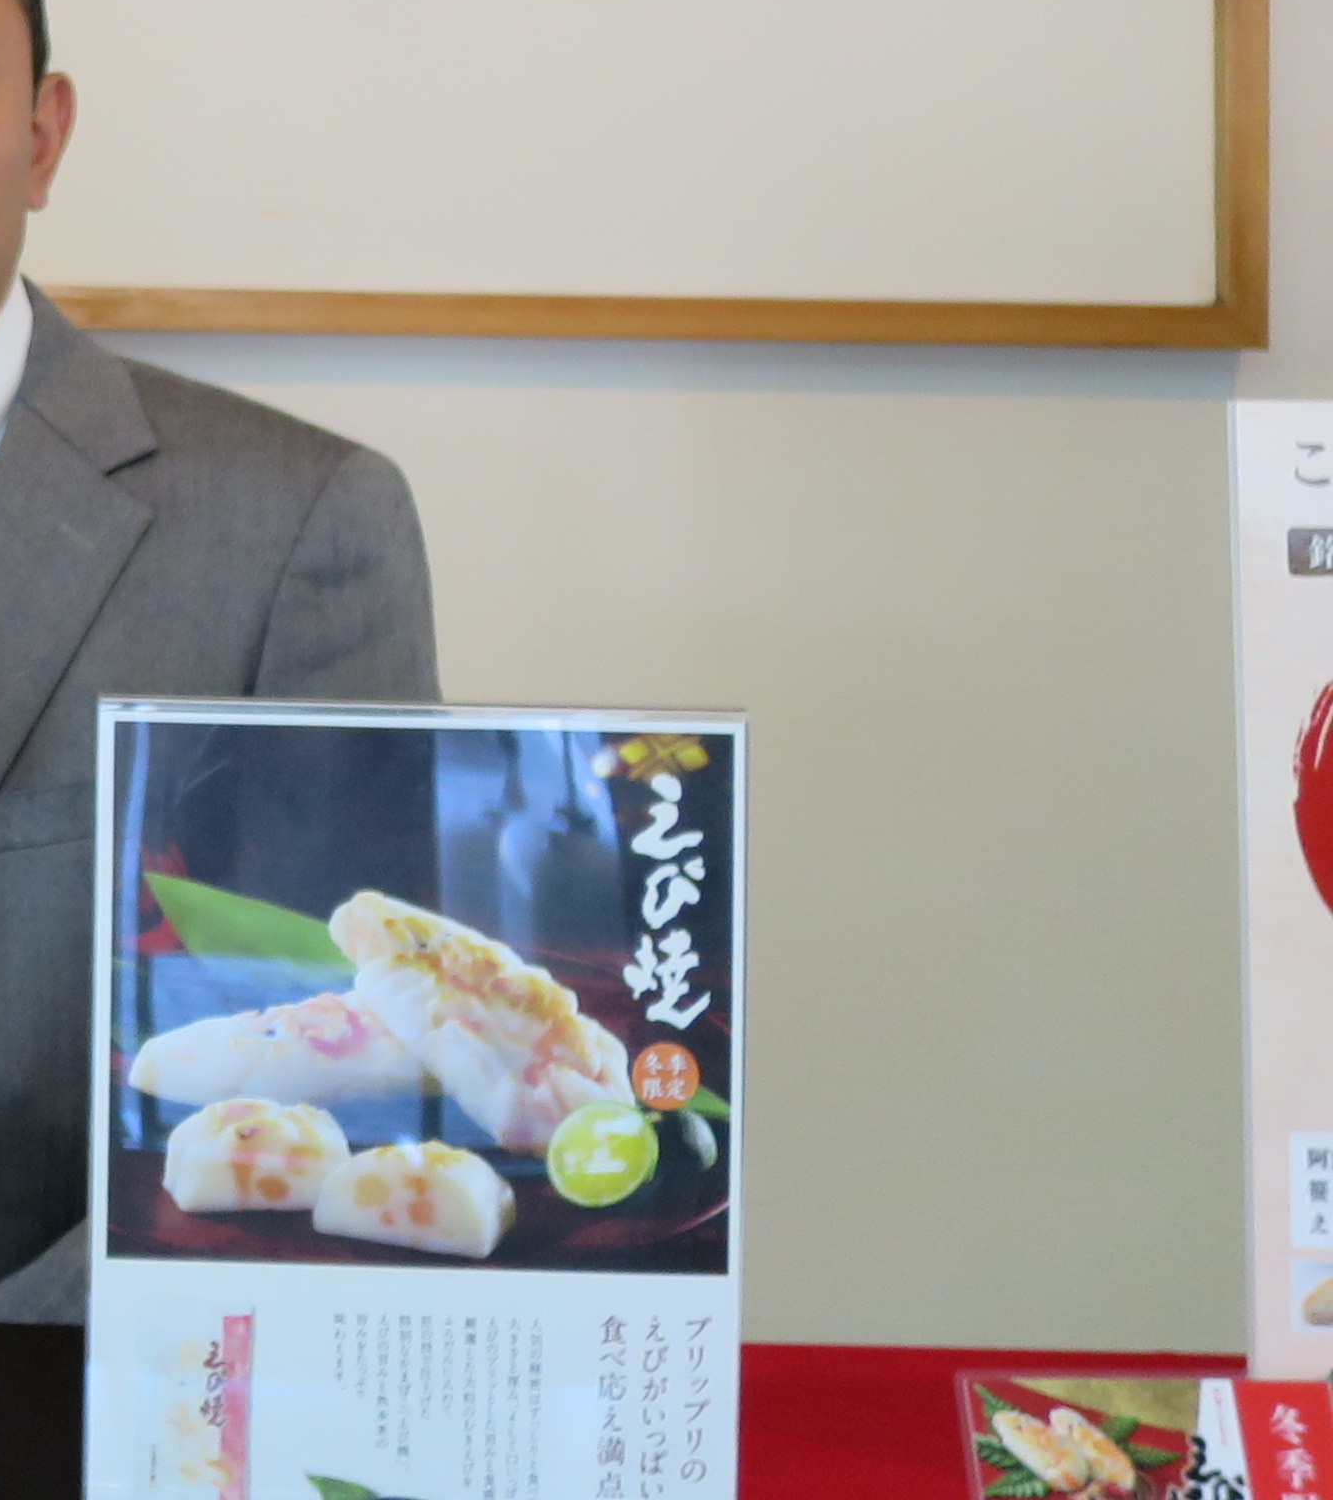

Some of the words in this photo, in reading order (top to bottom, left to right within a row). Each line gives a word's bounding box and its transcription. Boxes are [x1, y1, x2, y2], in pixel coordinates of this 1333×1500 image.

[622, 771, 712, 1031] えび焼
[596, 1314, 628, 1500] 食べ応え満点
[640, 1314, 670, 1500] えびがいっぱい
[680, 1314, 713, 1483] プリップリの
